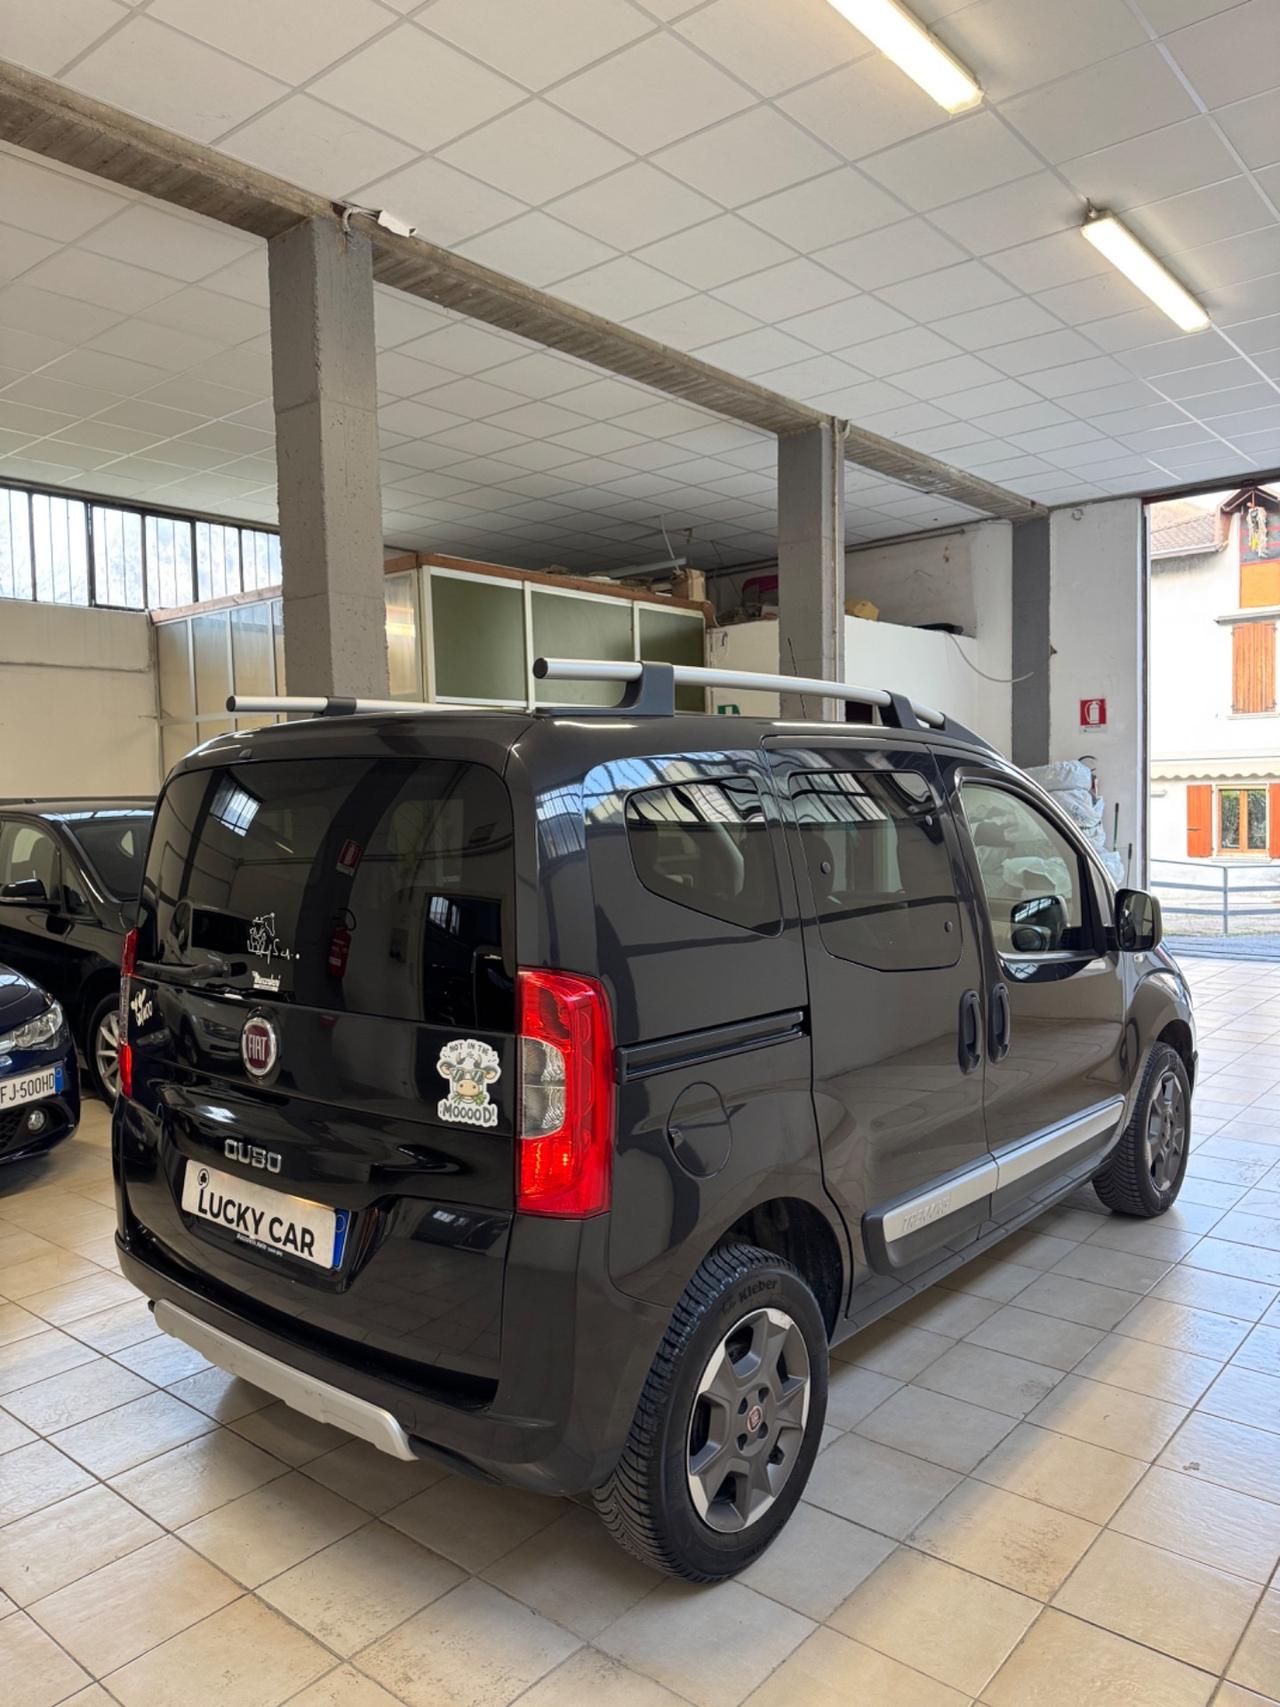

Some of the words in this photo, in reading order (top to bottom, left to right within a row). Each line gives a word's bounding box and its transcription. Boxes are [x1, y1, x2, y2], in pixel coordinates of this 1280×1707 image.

[248, 1034, 267, 1061] FIAT
[449, 1042, 463, 1052] NOT
[467, 1042, 475, 1050] IN
[478, 1045, 490, 1056] THE
[225, 1139, 282, 1173] QUBO
[198, 1187, 265, 1235] LUCKY
[268, 1216, 315, 1257] CAR
[738, 1279, 778, 1303] Kleber
